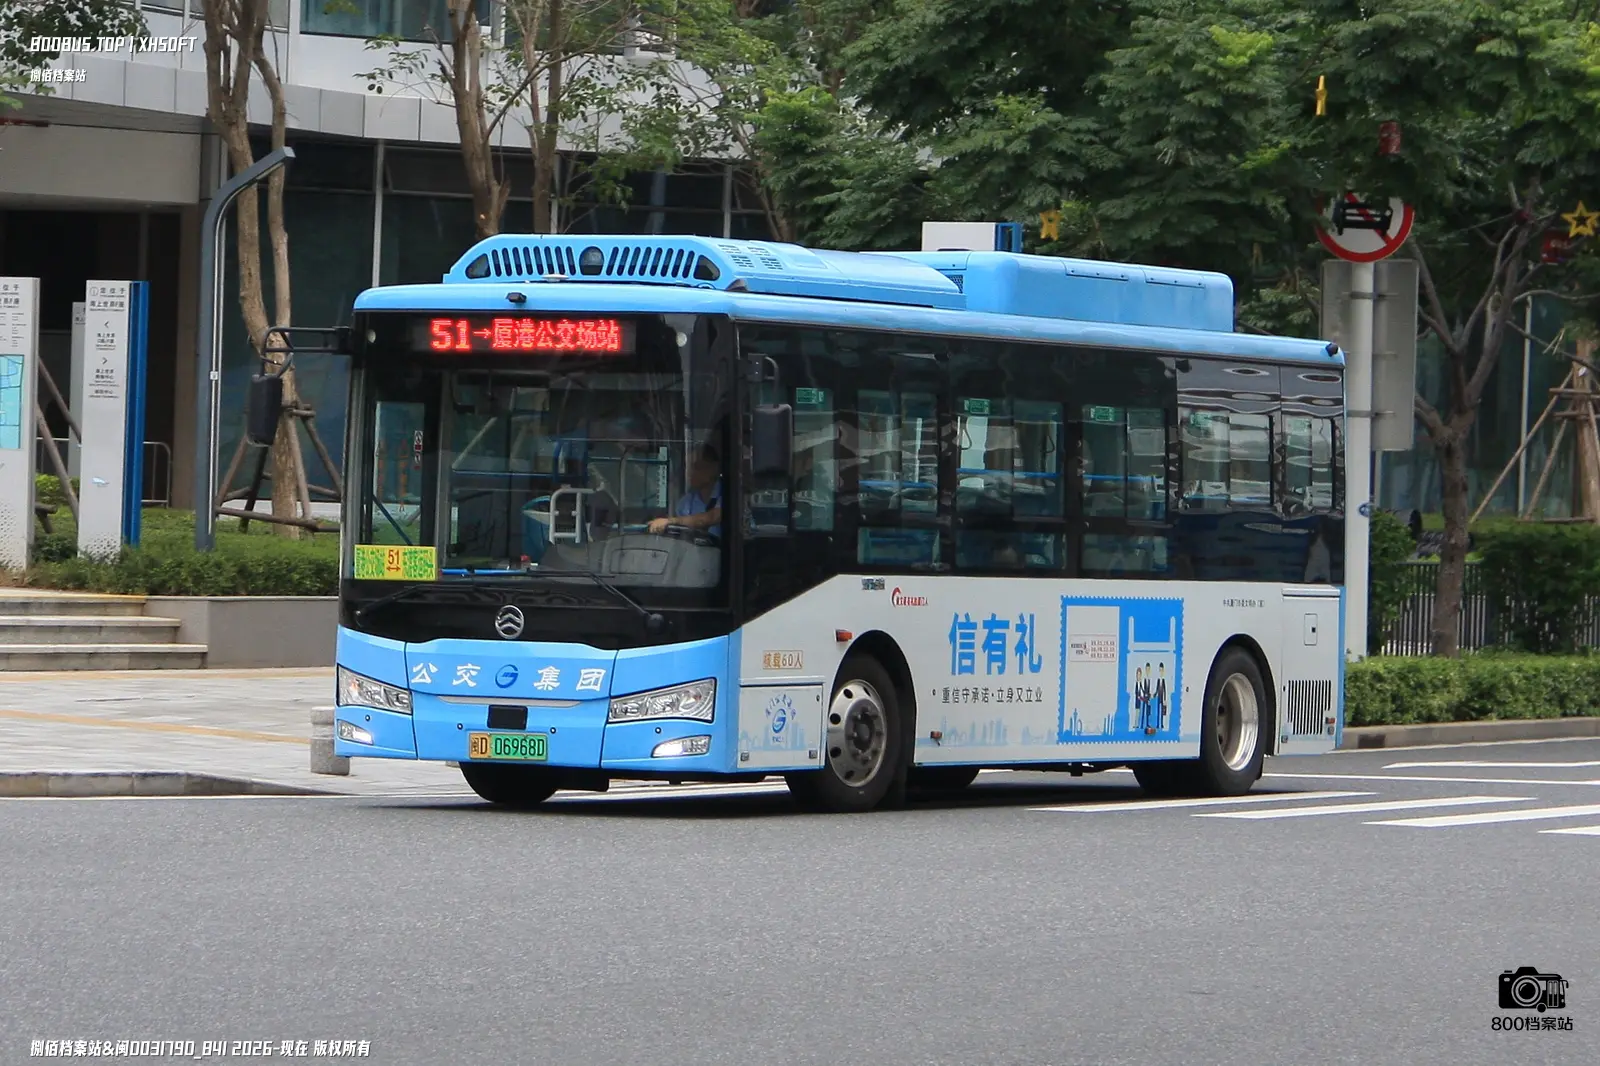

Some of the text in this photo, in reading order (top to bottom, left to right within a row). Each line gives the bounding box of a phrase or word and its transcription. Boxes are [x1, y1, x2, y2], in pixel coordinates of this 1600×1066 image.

[431, 318, 621, 350] 51 厦港公交场站
[387, 549, 401, 566] 51
[948, 612, 1043, 676] 信有礼
[411, 663, 481, 688] 公交
[533, 666, 607, 692] 集团
[942, 686, 1043, 704] 重信守承诺·立身又立业
[494, 737, 546, 757] 06968D
